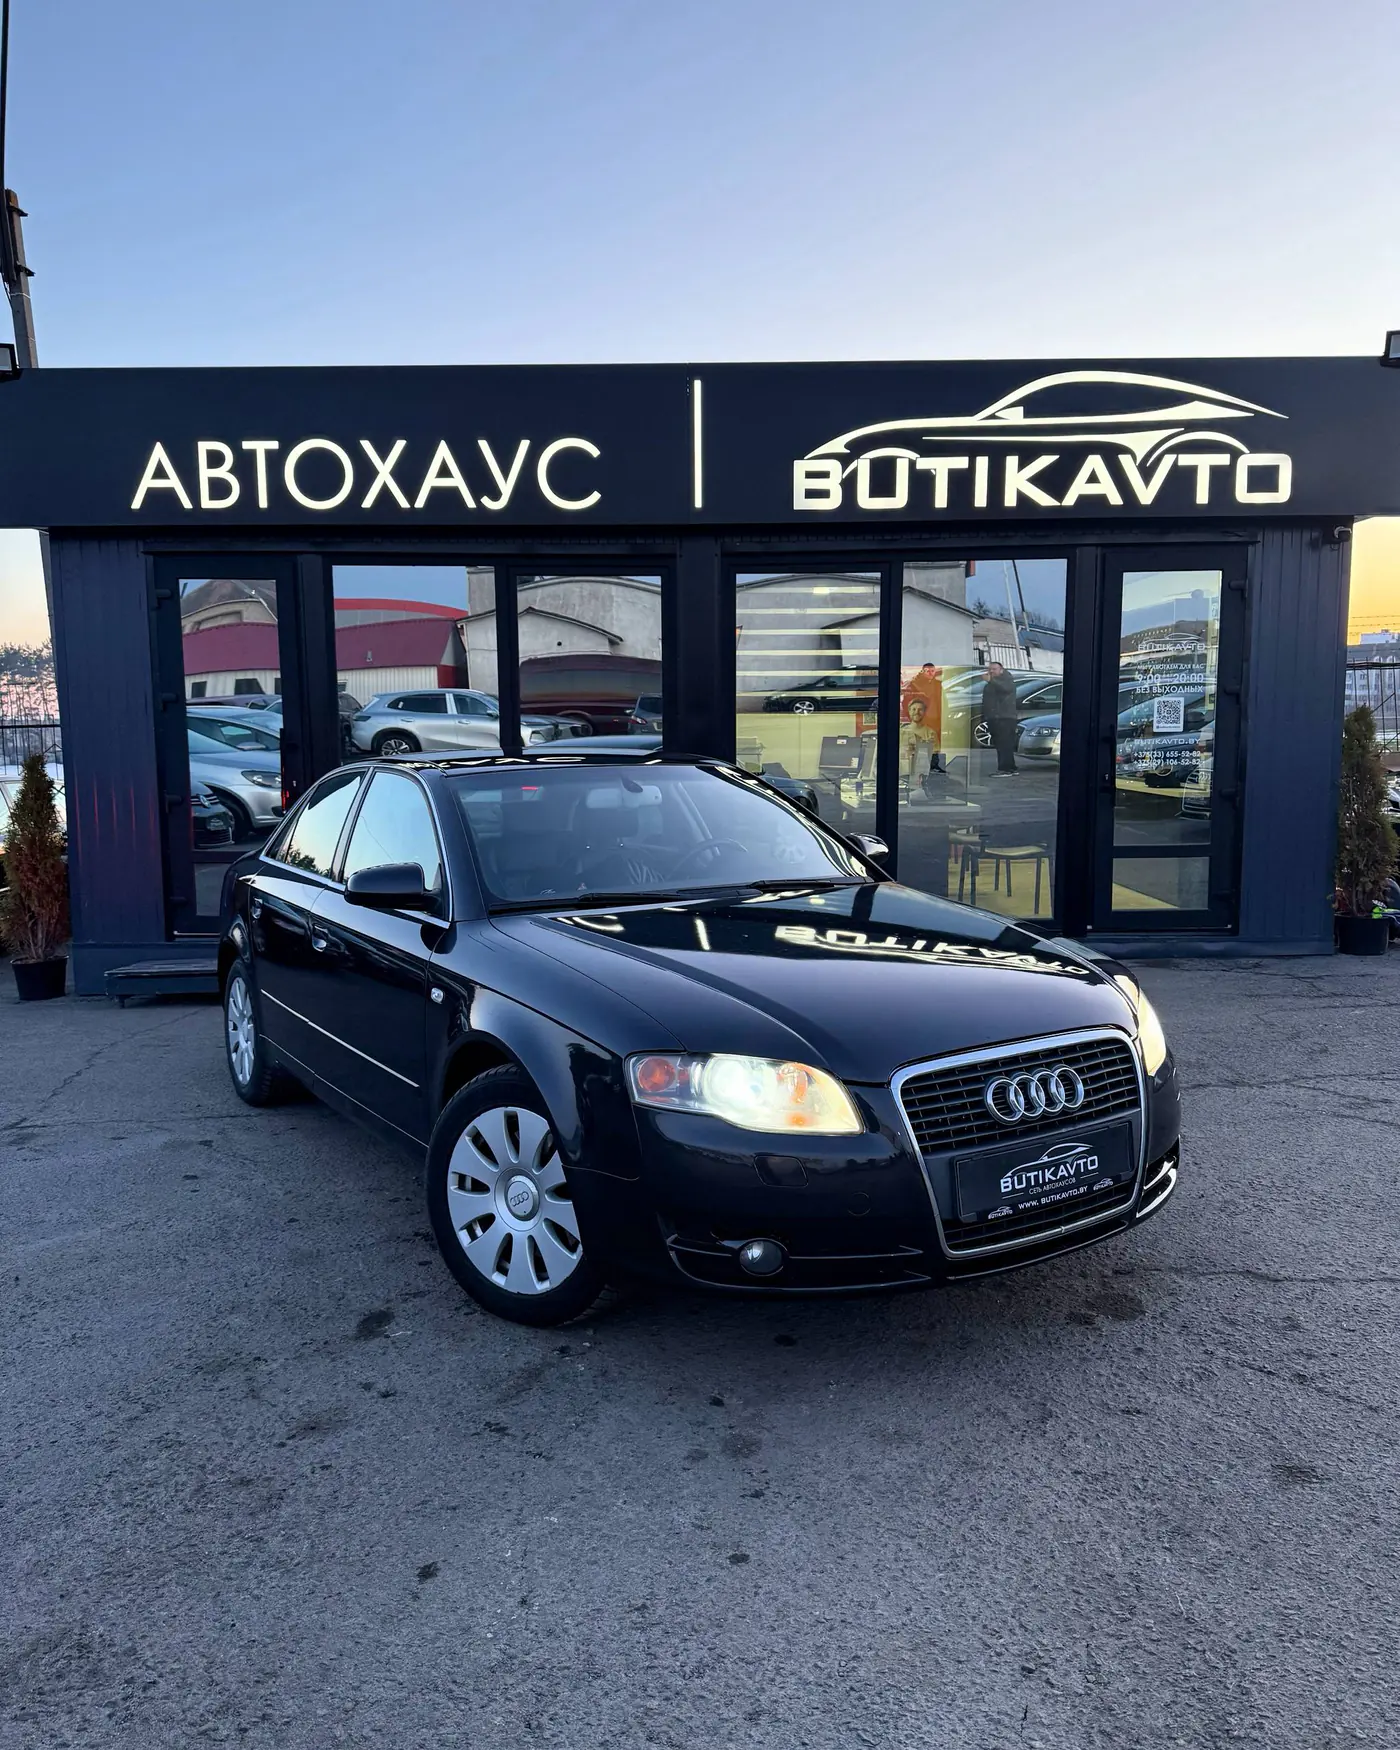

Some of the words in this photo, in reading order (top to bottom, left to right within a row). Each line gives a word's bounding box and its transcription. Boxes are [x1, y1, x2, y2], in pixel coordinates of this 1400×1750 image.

[131, 437, 602, 511] АВТОХАУС
[793, 453, 1293, 511] BUTIKAVTO
[1138, 643, 1206, 651] BUTIKAVTO
[1137, 673, 1161, 684] 9:00
[1173, 673, 1204, 683] 20:00
[1136, 686, 1150, 694] БЕЗ
[1152, 685, 1204, 694] ВЫХОДНЫХ
[1165, 750, 1201, 758] 655-52-82
[1165, 758, 1201, 766] 106-52-82
[1000, 1155, 1099, 1193] BUTIKAVTO
[1028, 1186, 1043, 1195] СЕТЬ
[1042, 1177, 1077, 1192] АВТОХАУСОВ
[1018, 1199, 1039, 1210] WWW.
[1040, 1185, 1089, 1205] BUTIKAVTO.BY
